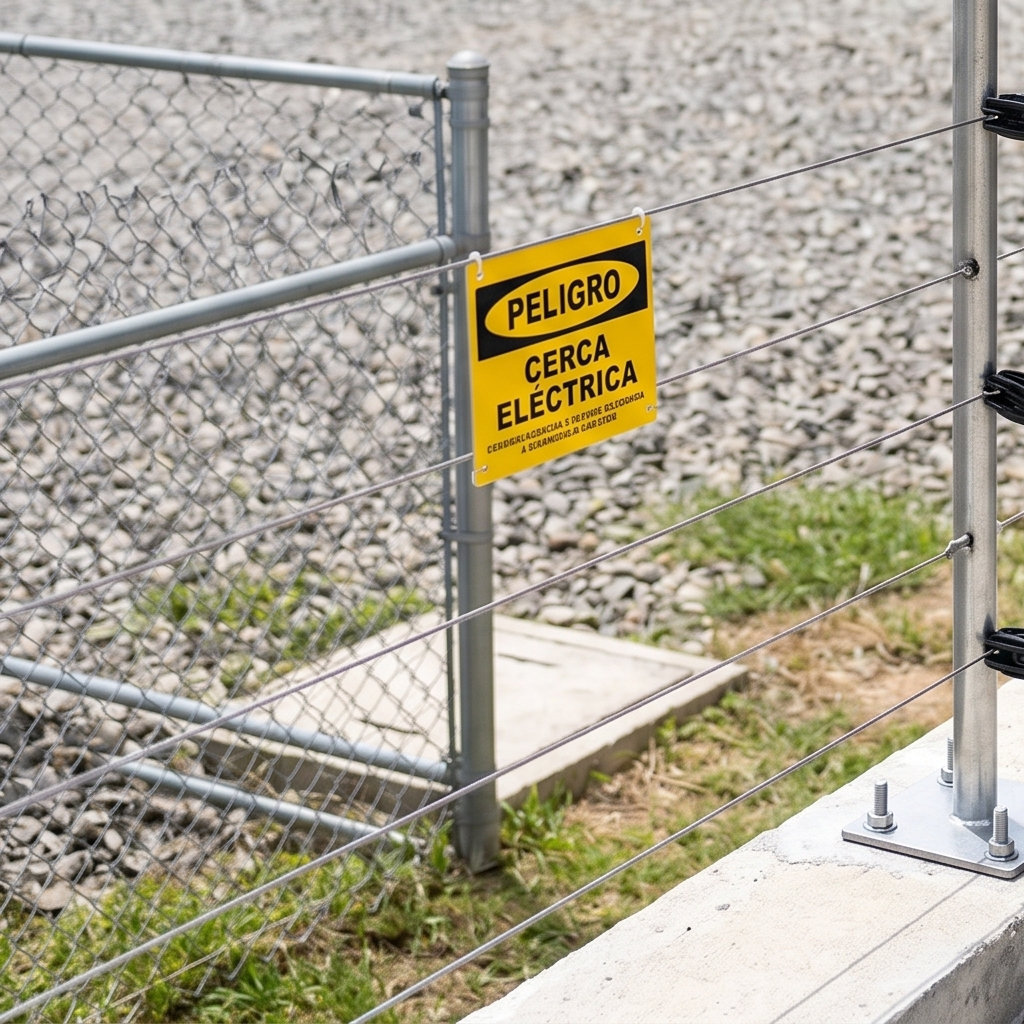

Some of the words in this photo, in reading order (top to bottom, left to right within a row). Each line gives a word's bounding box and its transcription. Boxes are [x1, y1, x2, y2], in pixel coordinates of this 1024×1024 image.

[507, 269, 621, 331] PELIGRO
[524, 334, 611, 384] CERCA
[496, 360, 638, 432] ELÉCTRICA
